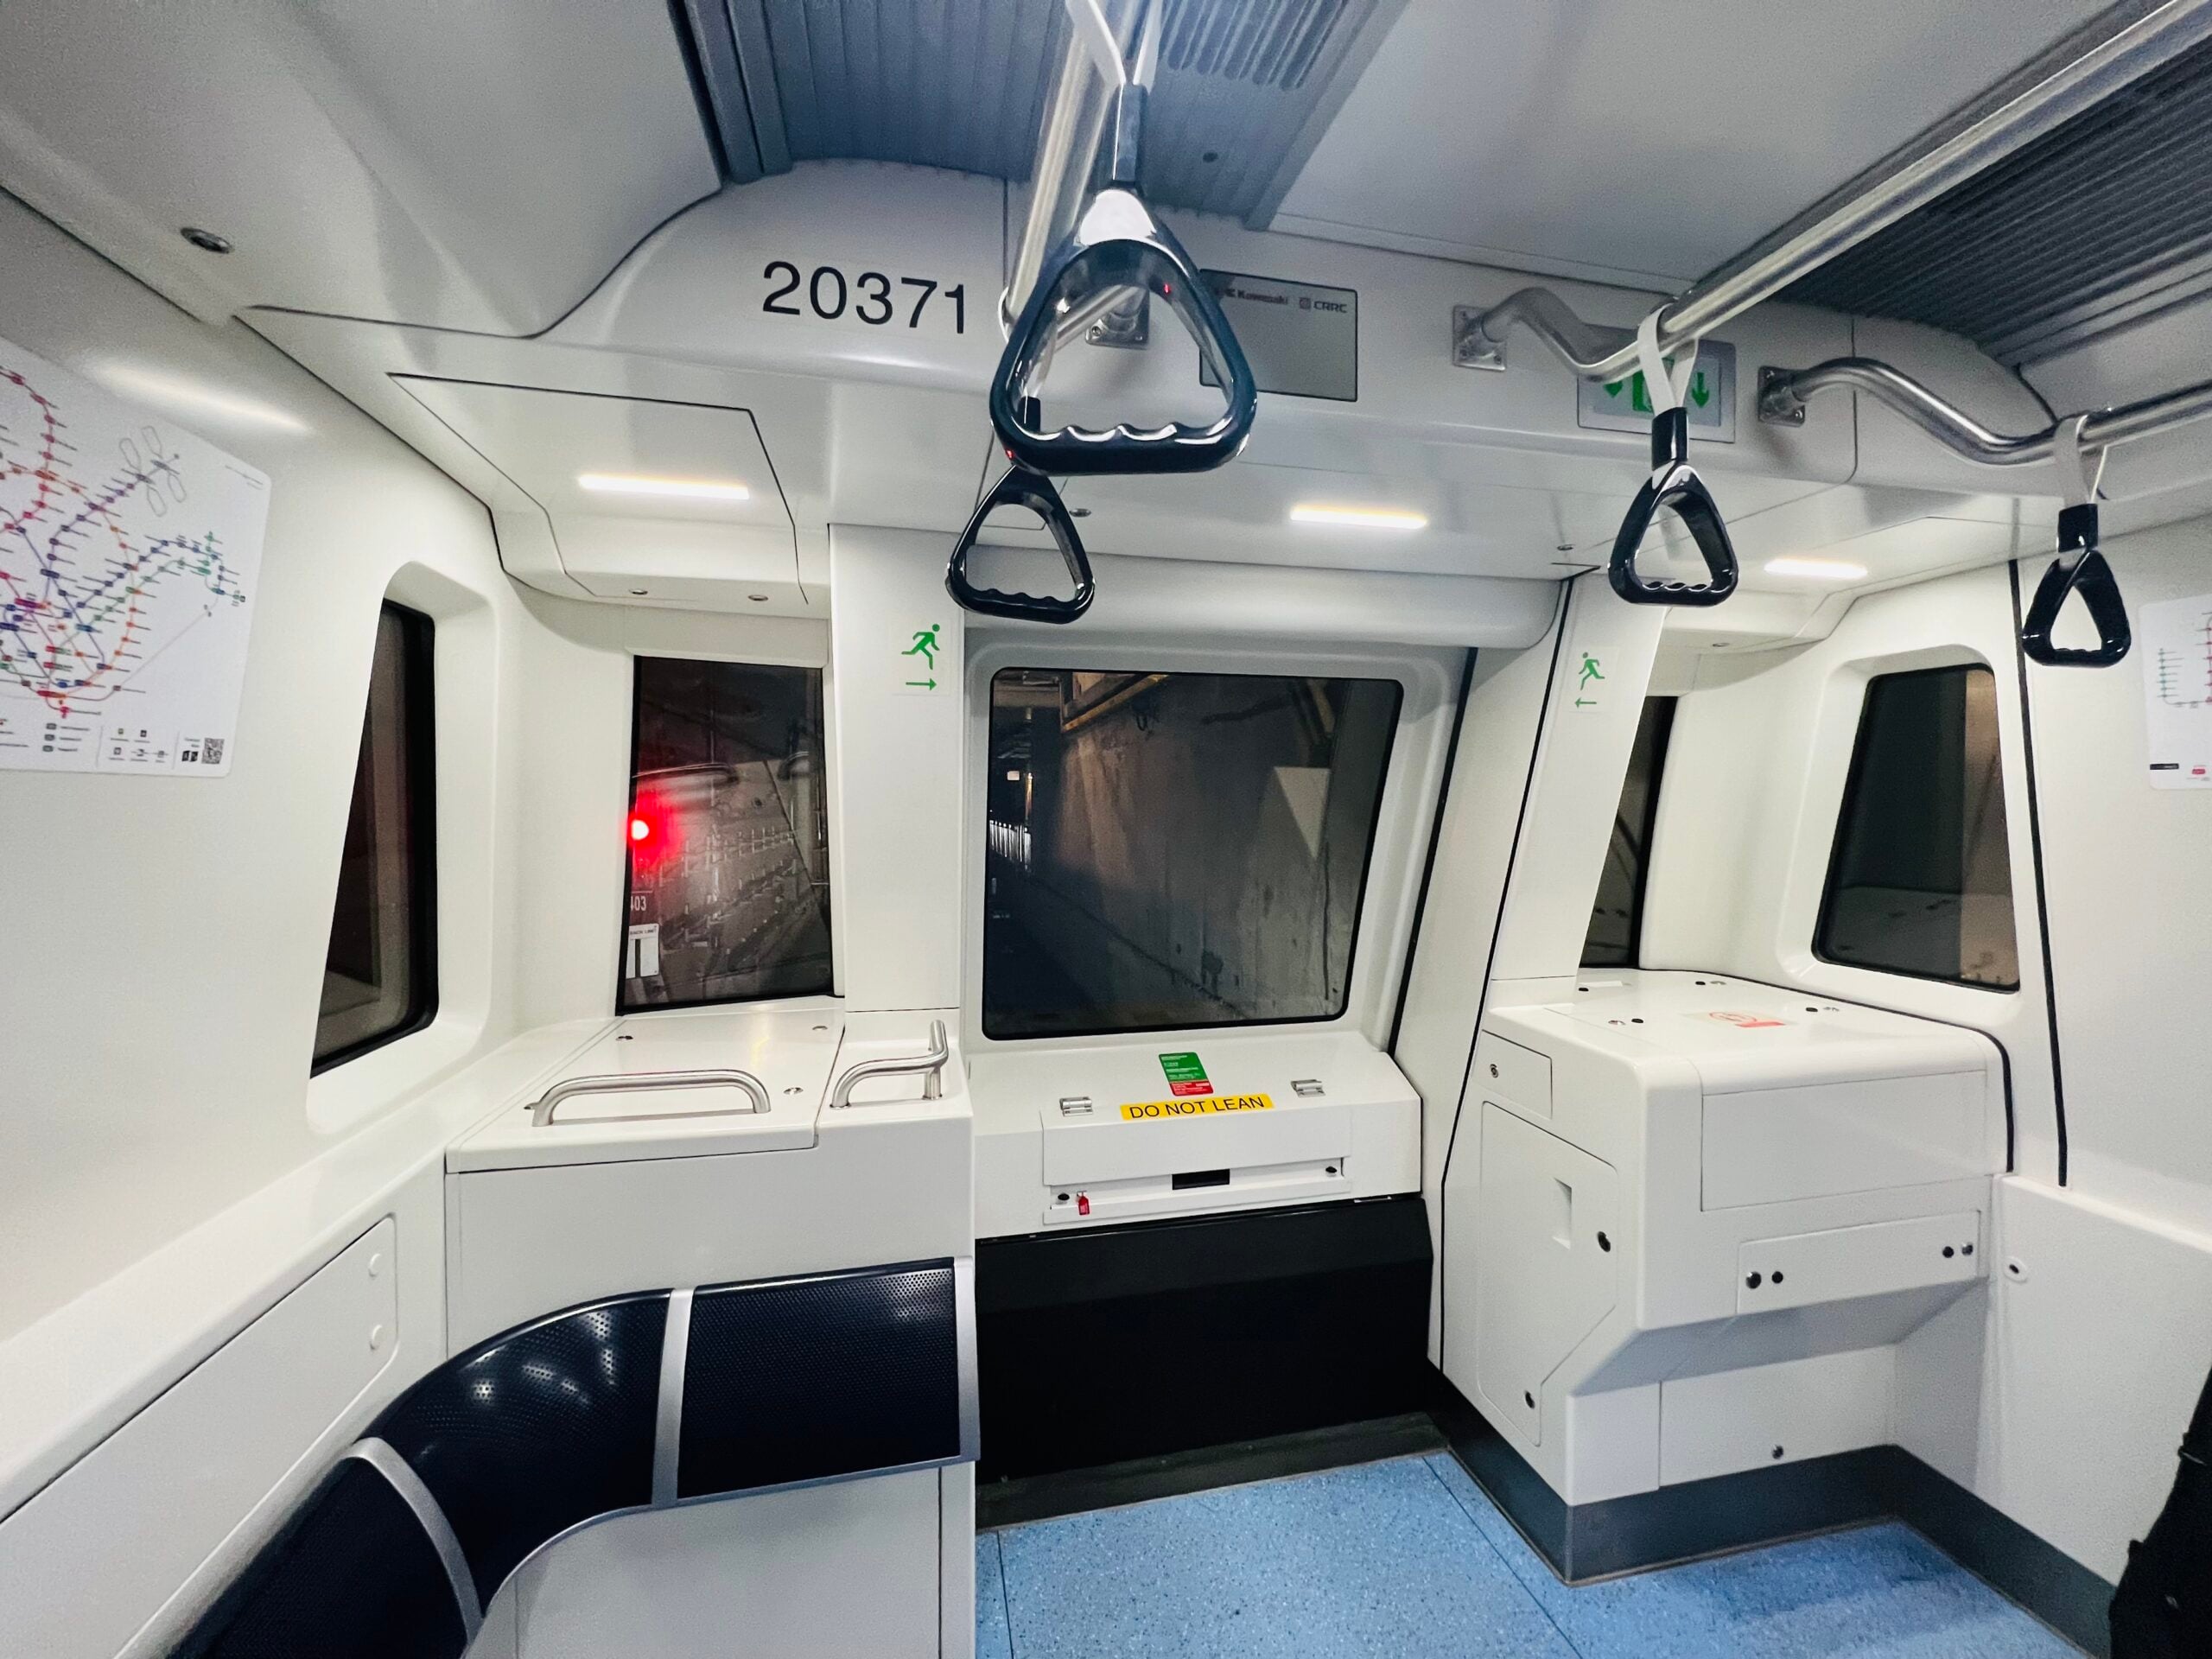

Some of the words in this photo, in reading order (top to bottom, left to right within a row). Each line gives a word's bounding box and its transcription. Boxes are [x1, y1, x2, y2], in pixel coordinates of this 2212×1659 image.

[763, 261, 964, 334] 20371
[1313, 300, 1347, 313] CRRC
[1129, 1105, 1160, 1119] DO
[1165, 1101, 1205, 1116] NOT
[1212, 1096, 1265, 1111] LEAN
